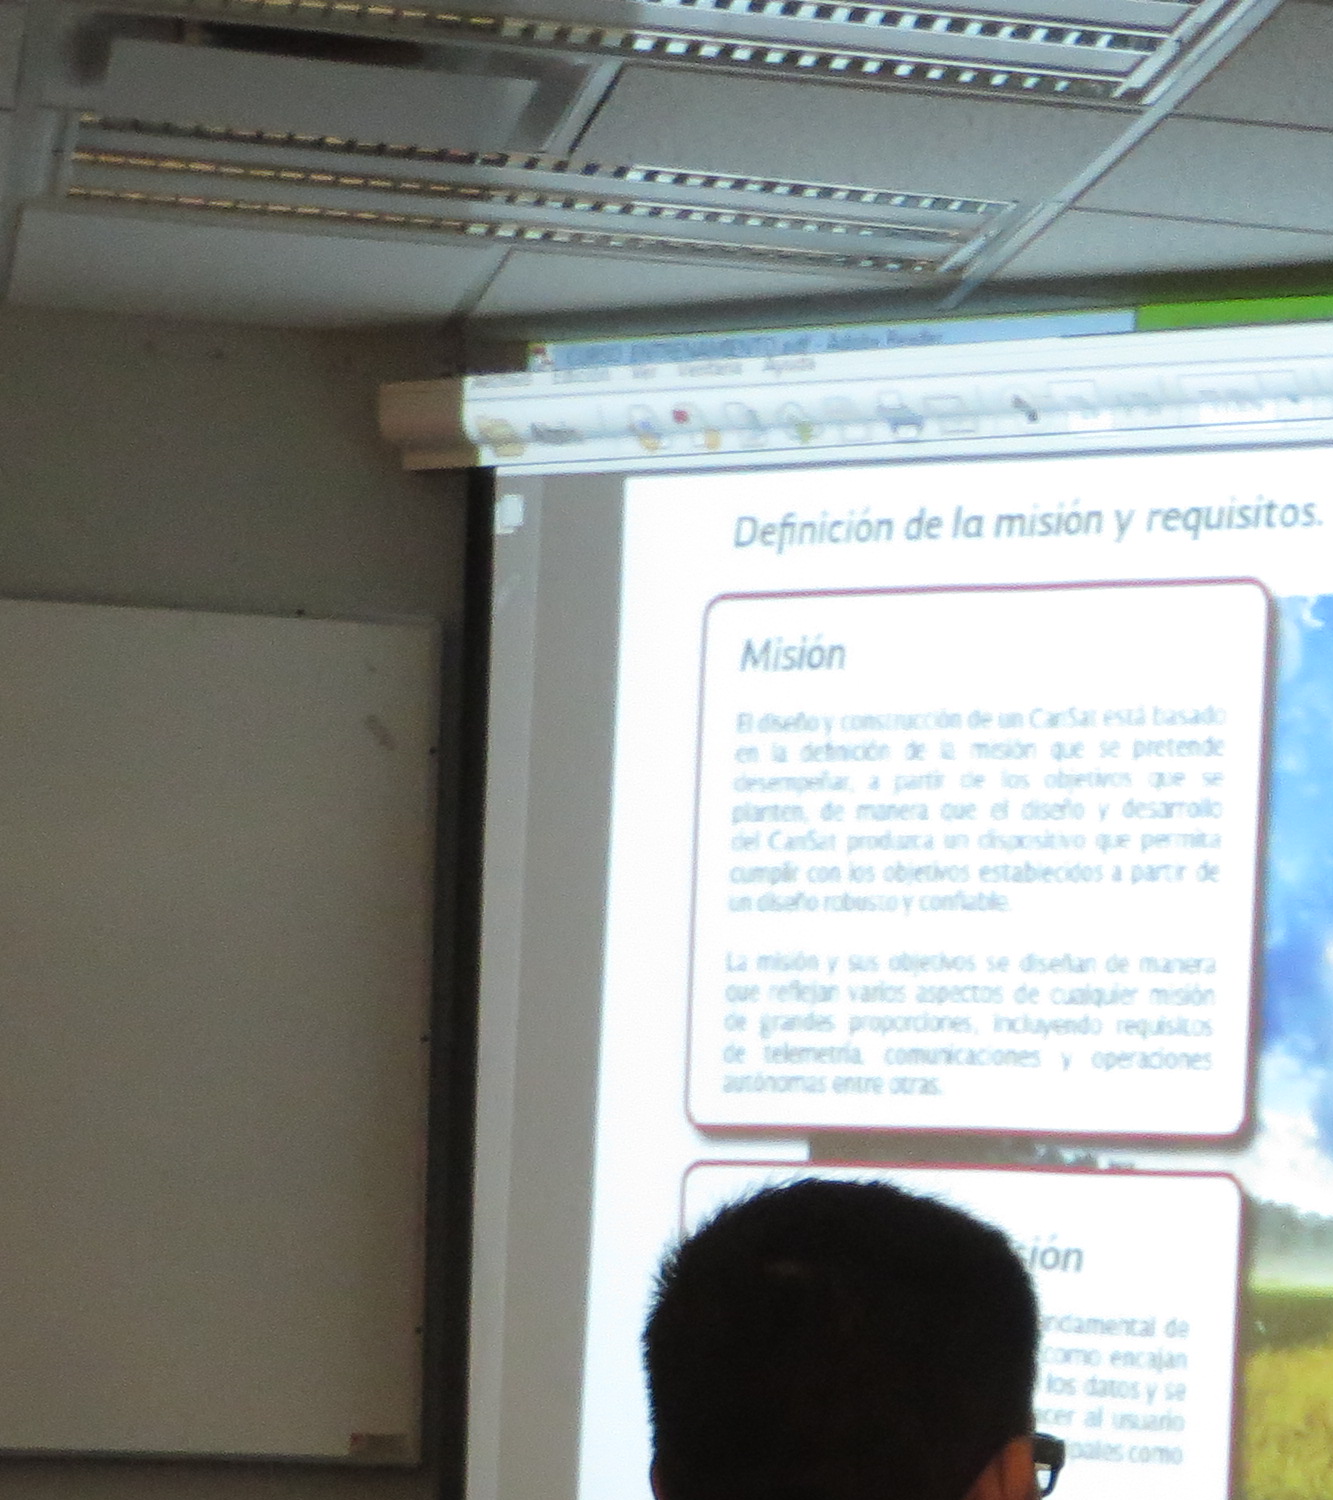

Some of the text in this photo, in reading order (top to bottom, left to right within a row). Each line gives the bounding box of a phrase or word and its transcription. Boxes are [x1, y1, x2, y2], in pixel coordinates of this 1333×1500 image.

[733, 496, 1323, 552] Definición de la misión y requisitos.
[739, 634, 846, 673] Misión
